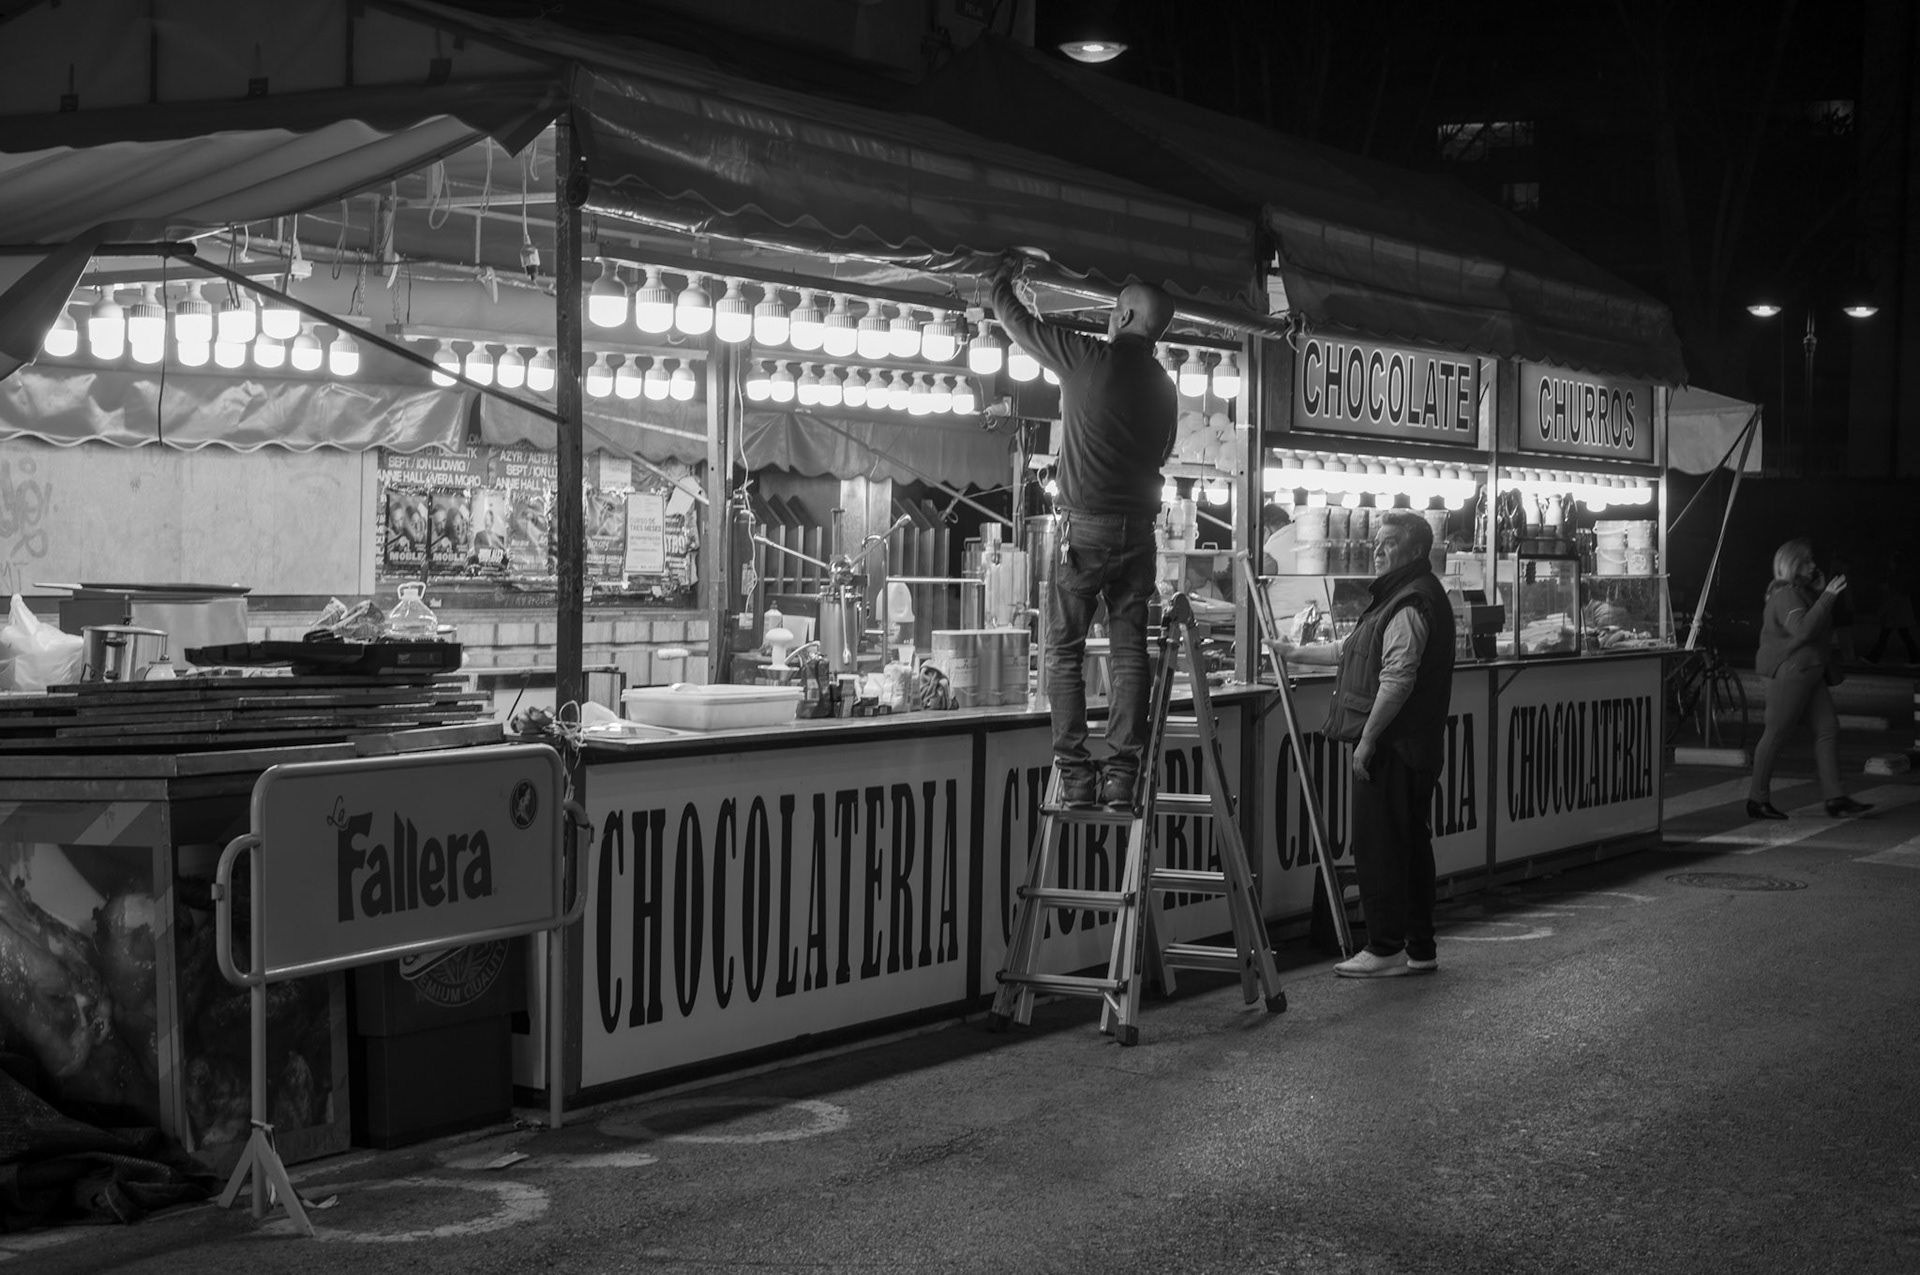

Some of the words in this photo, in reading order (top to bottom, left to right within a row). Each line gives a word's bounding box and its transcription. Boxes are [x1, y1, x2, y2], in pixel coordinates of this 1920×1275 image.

[1301, 337, 1472, 432] CHOCOLATE
[1537, 376, 1637, 451] CHURROS
[377, 468, 403, 483] ANNIE
[403, 470, 425, 484] HALL
[430, 473, 454, 486] VERA
[454, 474, 481, 487] MORO
[388, 456, 411, 468] SEPT
[416, 458, 432, 470] ION
[432, 458, 466, 472] LUDWIG
[506, 464, 528, 477] SEPT
[520, 478, 541, 491] HALL
[1506, 695, 1653, 822] CHOCOLATERIA
[326, 795, 350, 831] La
[337, 811, 493, 923] Fallera
[595, 777, 960, 1035] CHOCOLATERIA
[418, 974, 461, 1003] EMIUM
